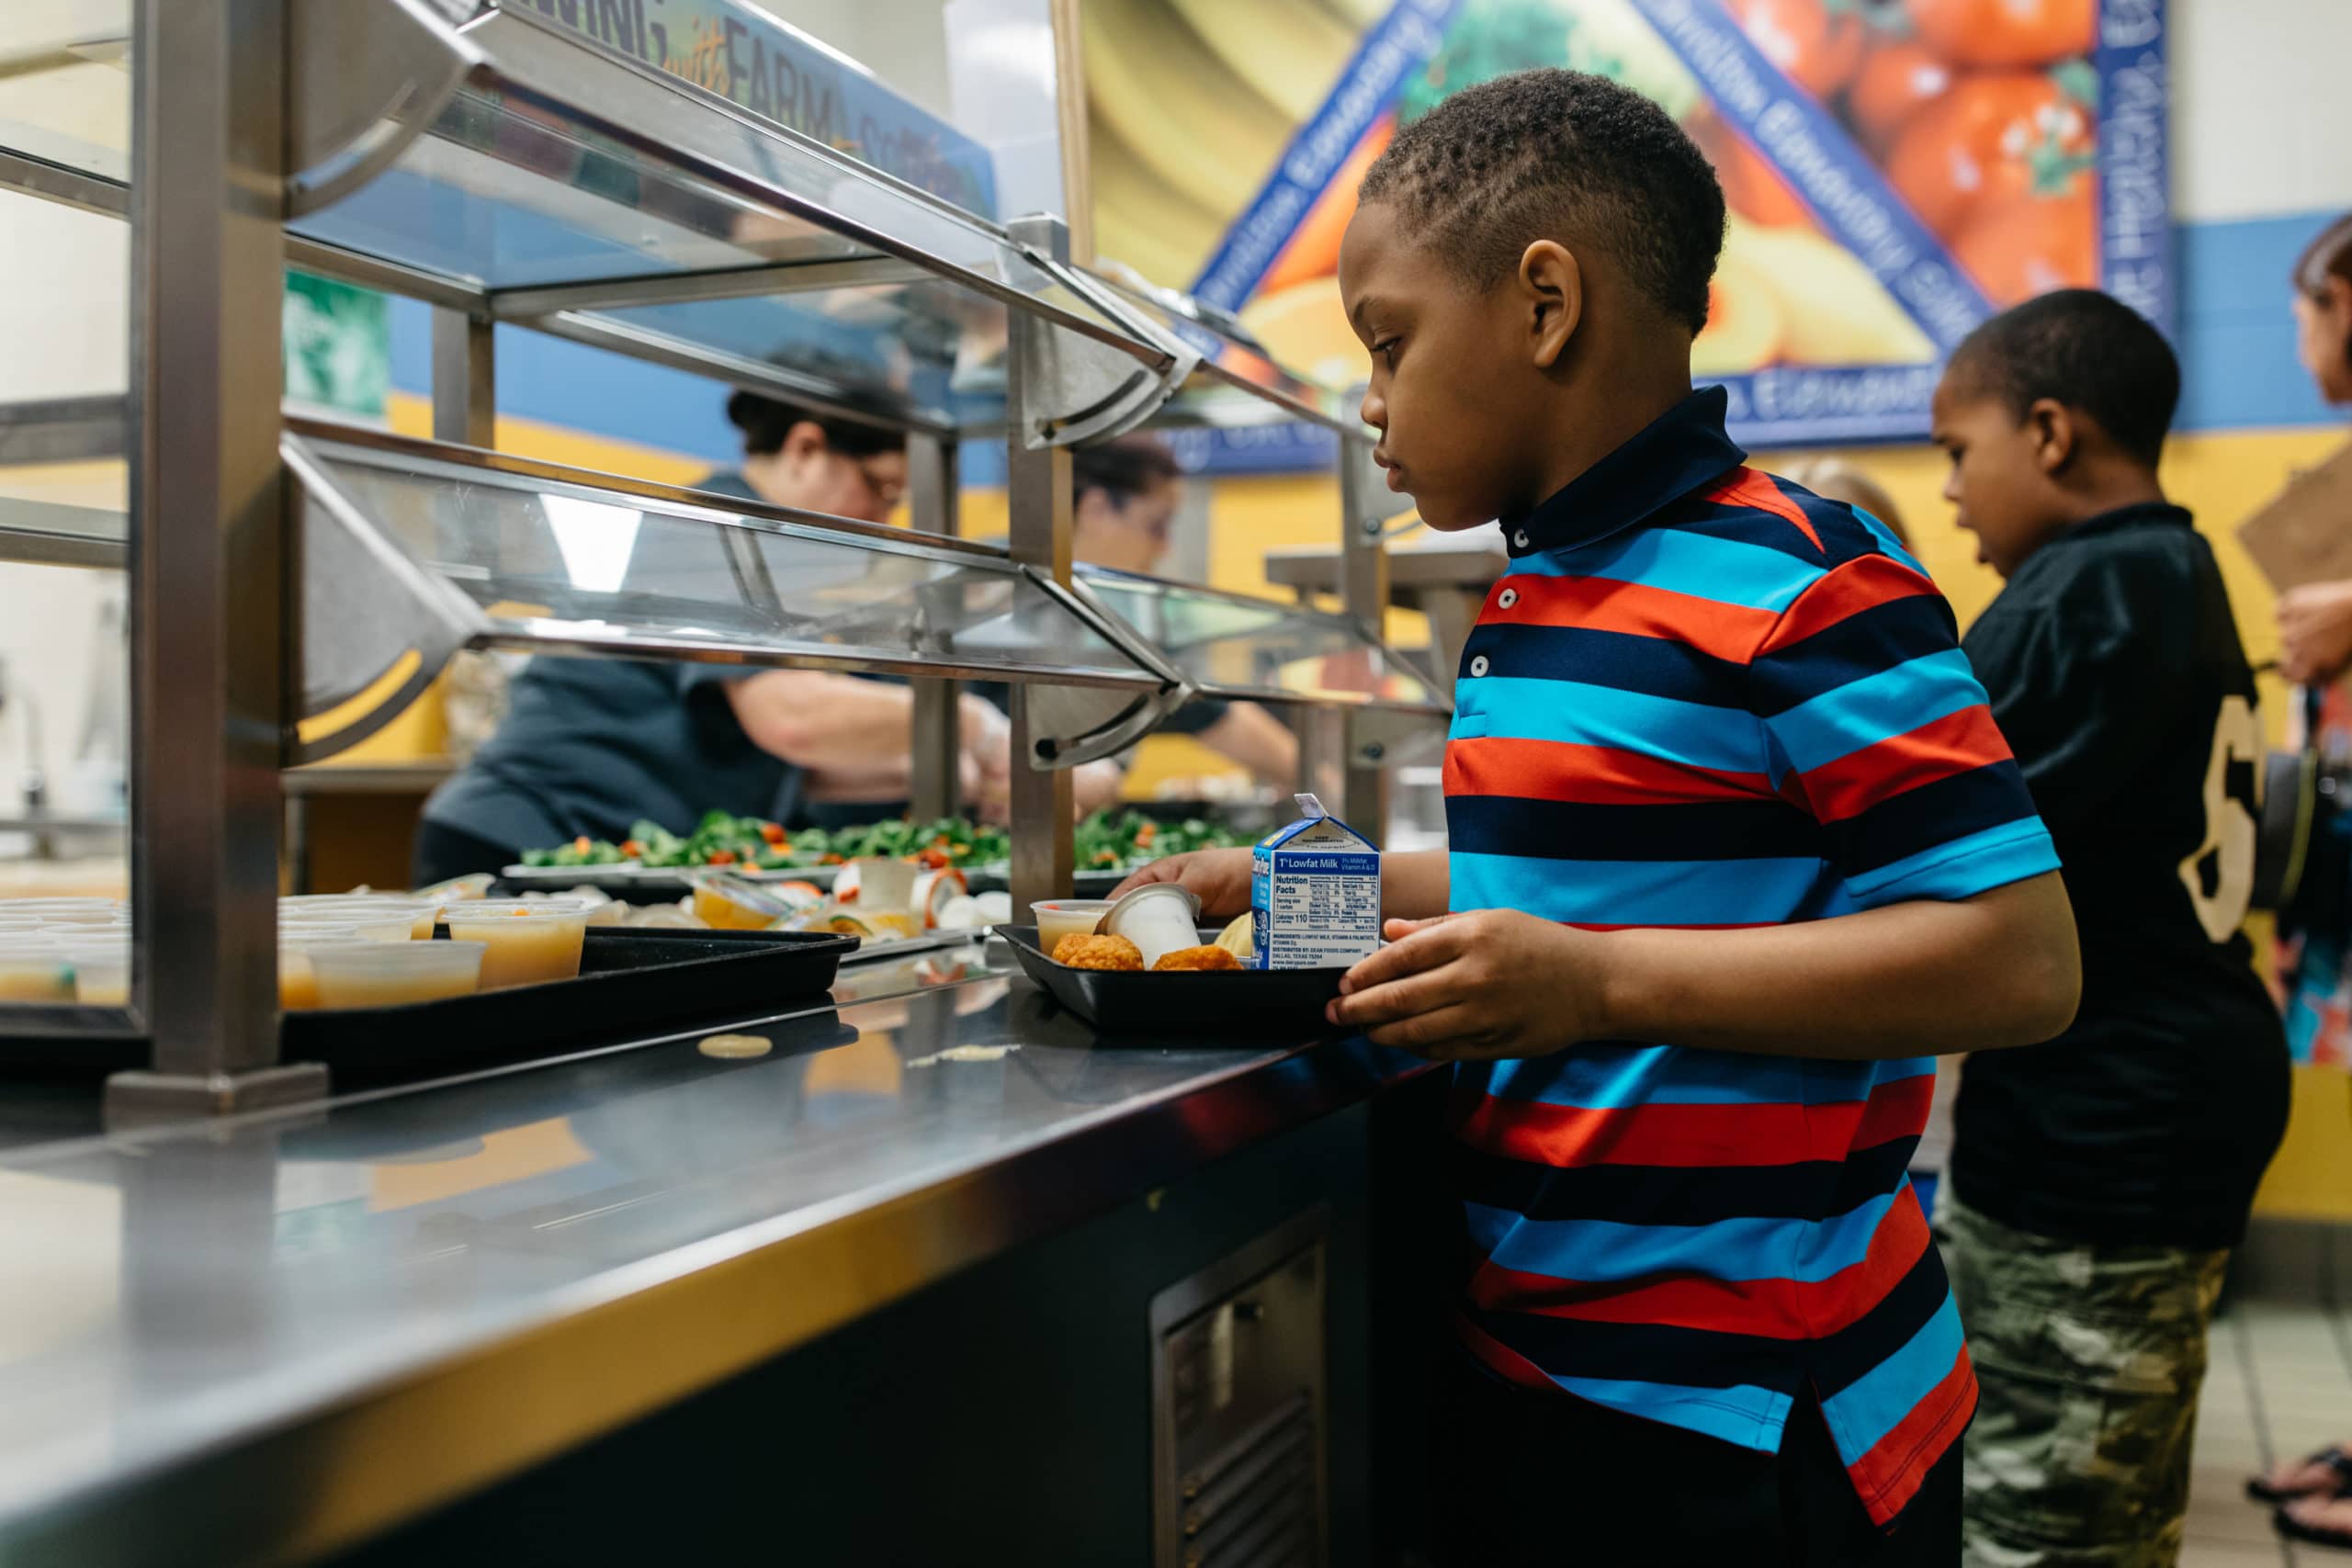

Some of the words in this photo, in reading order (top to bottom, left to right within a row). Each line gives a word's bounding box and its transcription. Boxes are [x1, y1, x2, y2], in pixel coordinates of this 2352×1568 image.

[1289, 858, 1318, 868] Lowfat
[1319, 858, 1338, 869] Milk
[1276, 875, 1307, 885] Nutrition
[1276, 886, 1295, 894] Facts
[1295, 915, 1307, 923] 110
